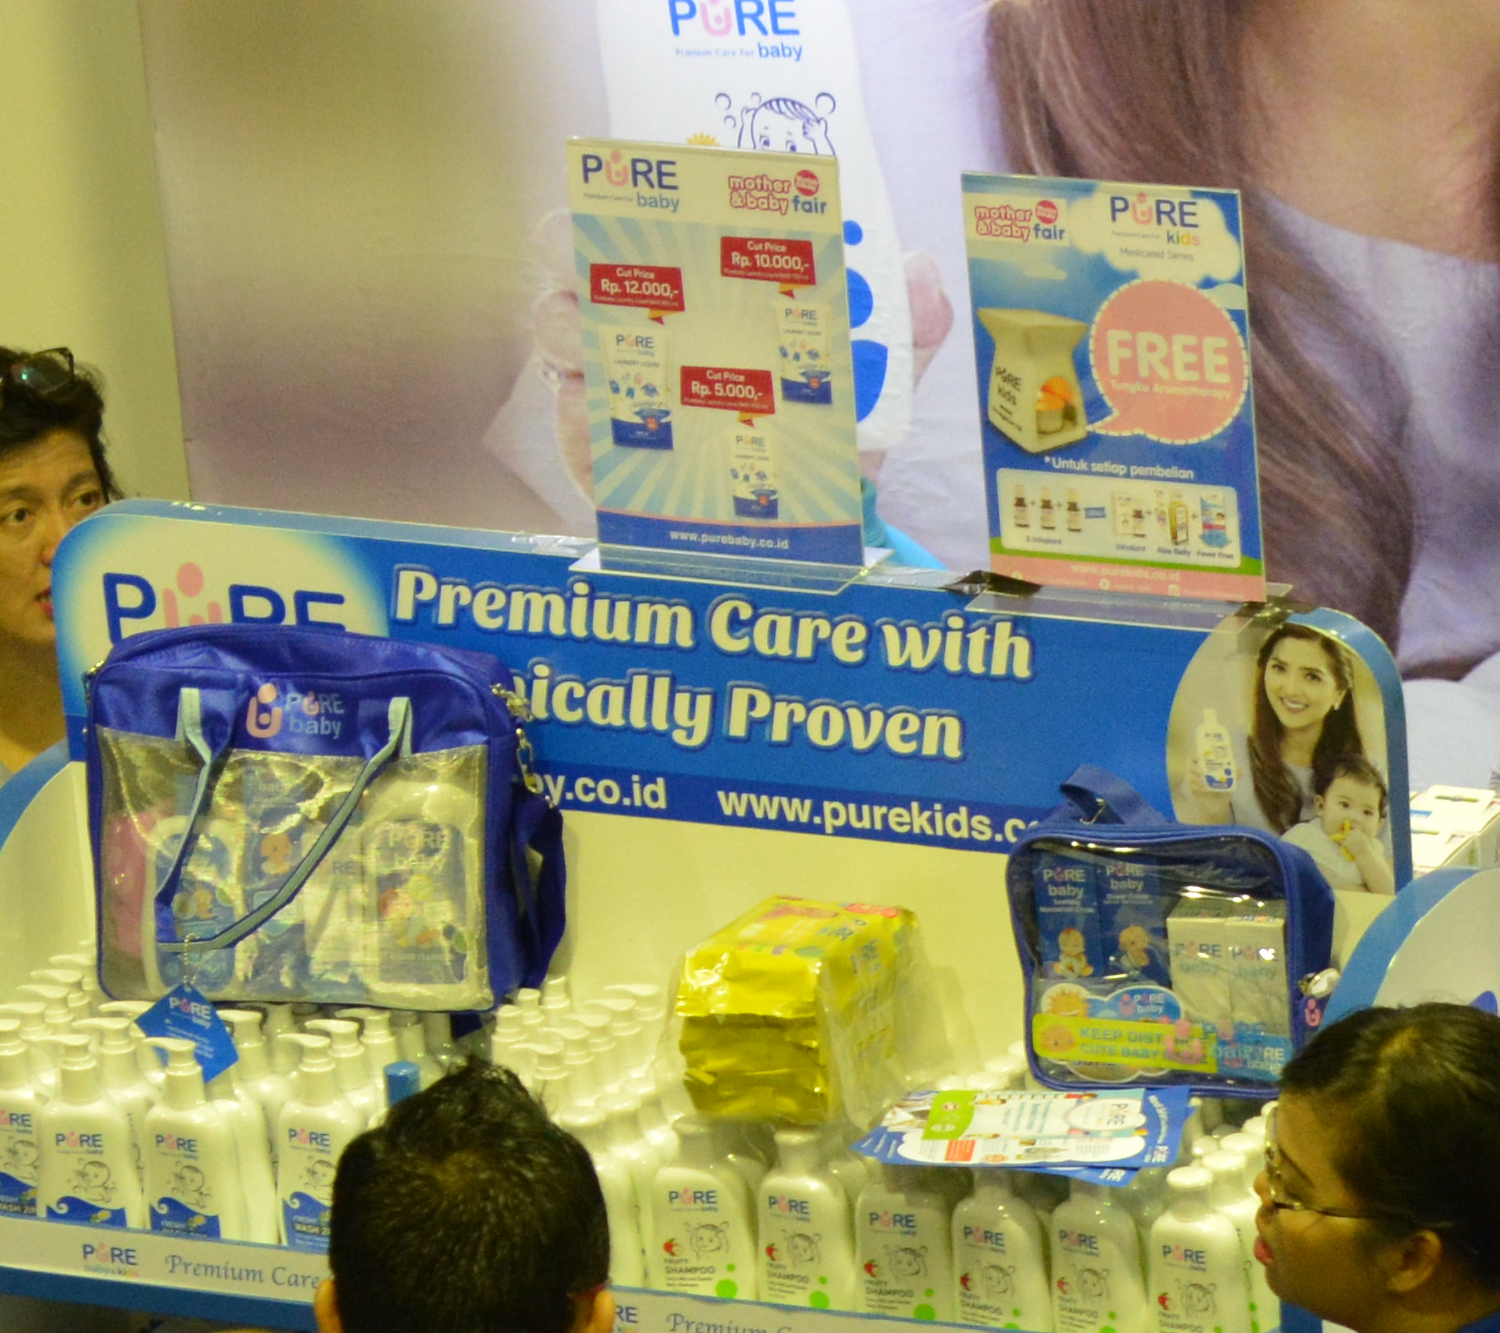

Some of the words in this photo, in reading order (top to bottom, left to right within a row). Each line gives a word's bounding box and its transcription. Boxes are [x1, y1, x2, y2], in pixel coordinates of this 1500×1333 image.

[758, 42, 802, 61] baby
[581, 150, 678, 190] PURE
[728, 174, 791, 195] mother
[636, 192, 679, 212] baby
[792, 196, 826, 214] fair
[1110, 192, 1199, 229] PURE
[974, 205, 1033, 222] mother
[1033, 224, 1065, 241] fair
[1166, 230, 1201, 246] kids
[747, 240, 762, 251] Cut
[764, 241, 786, 253] Price
[732, 252, 751, 267] Rp.
[617, 267, 631, 278] Cut
[633, 268, 655, 279] Price
[601, 278, 620, 294] Rp.
[1107, 329, 1230, 384] FREE
[707, 370, 721, 381] Cut
[723, 371, 745, 382] Price
[692, 381, 712, 397] Rp.
[1153, 382, 1231, 400] Aromatherapy
[1091, 461, 1127, 476] setiap
[1130, 463, 1194, 480] pembelian
[670, 529, 788, 550] www.purebaby.co.id
[391, 563, 695, 650] Premium
[707, 593, 869, 664] Care
[878, 610, 1035, 682] with
[726, 682, 967, 762] Proven
[165, 1254, 264, 1284] Premium
[271, 1267, 320, 1290] Care
[665, 1265, 715, 1275] SHAMPOO
